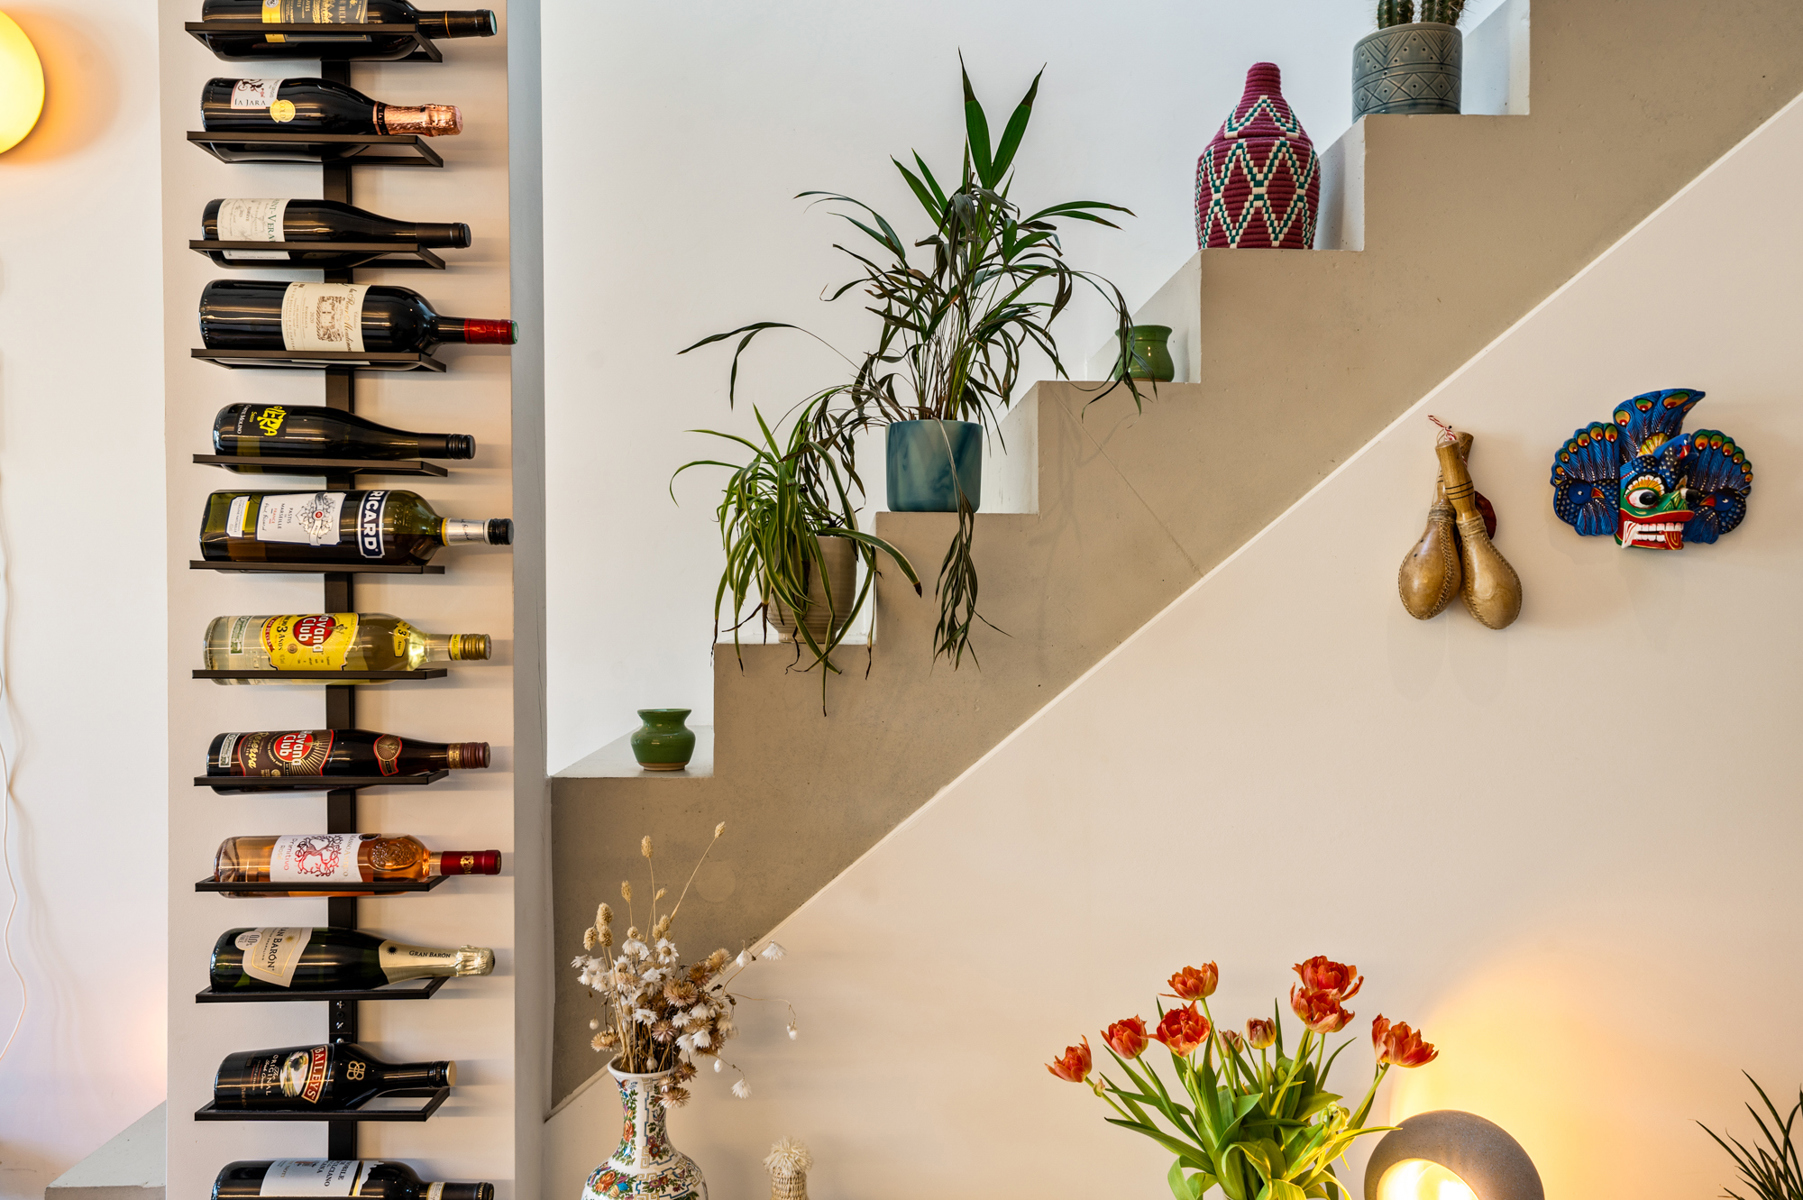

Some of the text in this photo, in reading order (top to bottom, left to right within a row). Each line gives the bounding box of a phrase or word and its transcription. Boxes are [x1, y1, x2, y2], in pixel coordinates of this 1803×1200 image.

[234, 98, 266, 107] LA JARA
[277, 503, 285, 529] MARSEILLE
[363, 490, 385, 550] RICARD
[298, 617, 316, 642] Club
[248, 732, 269, 769] Reserva
[279, 734, 297, 757] Club
[283, 838, 298, 871] Primitivo
[342, 849, 351, 877] ANTICO
[267, 938, 283, 968] BARÓN
[265, 1054, 279, 1096] ORIGINAL
[272, 1066, 280, 1081] The
[306, 1047, 325, 1099] BAILEYS
